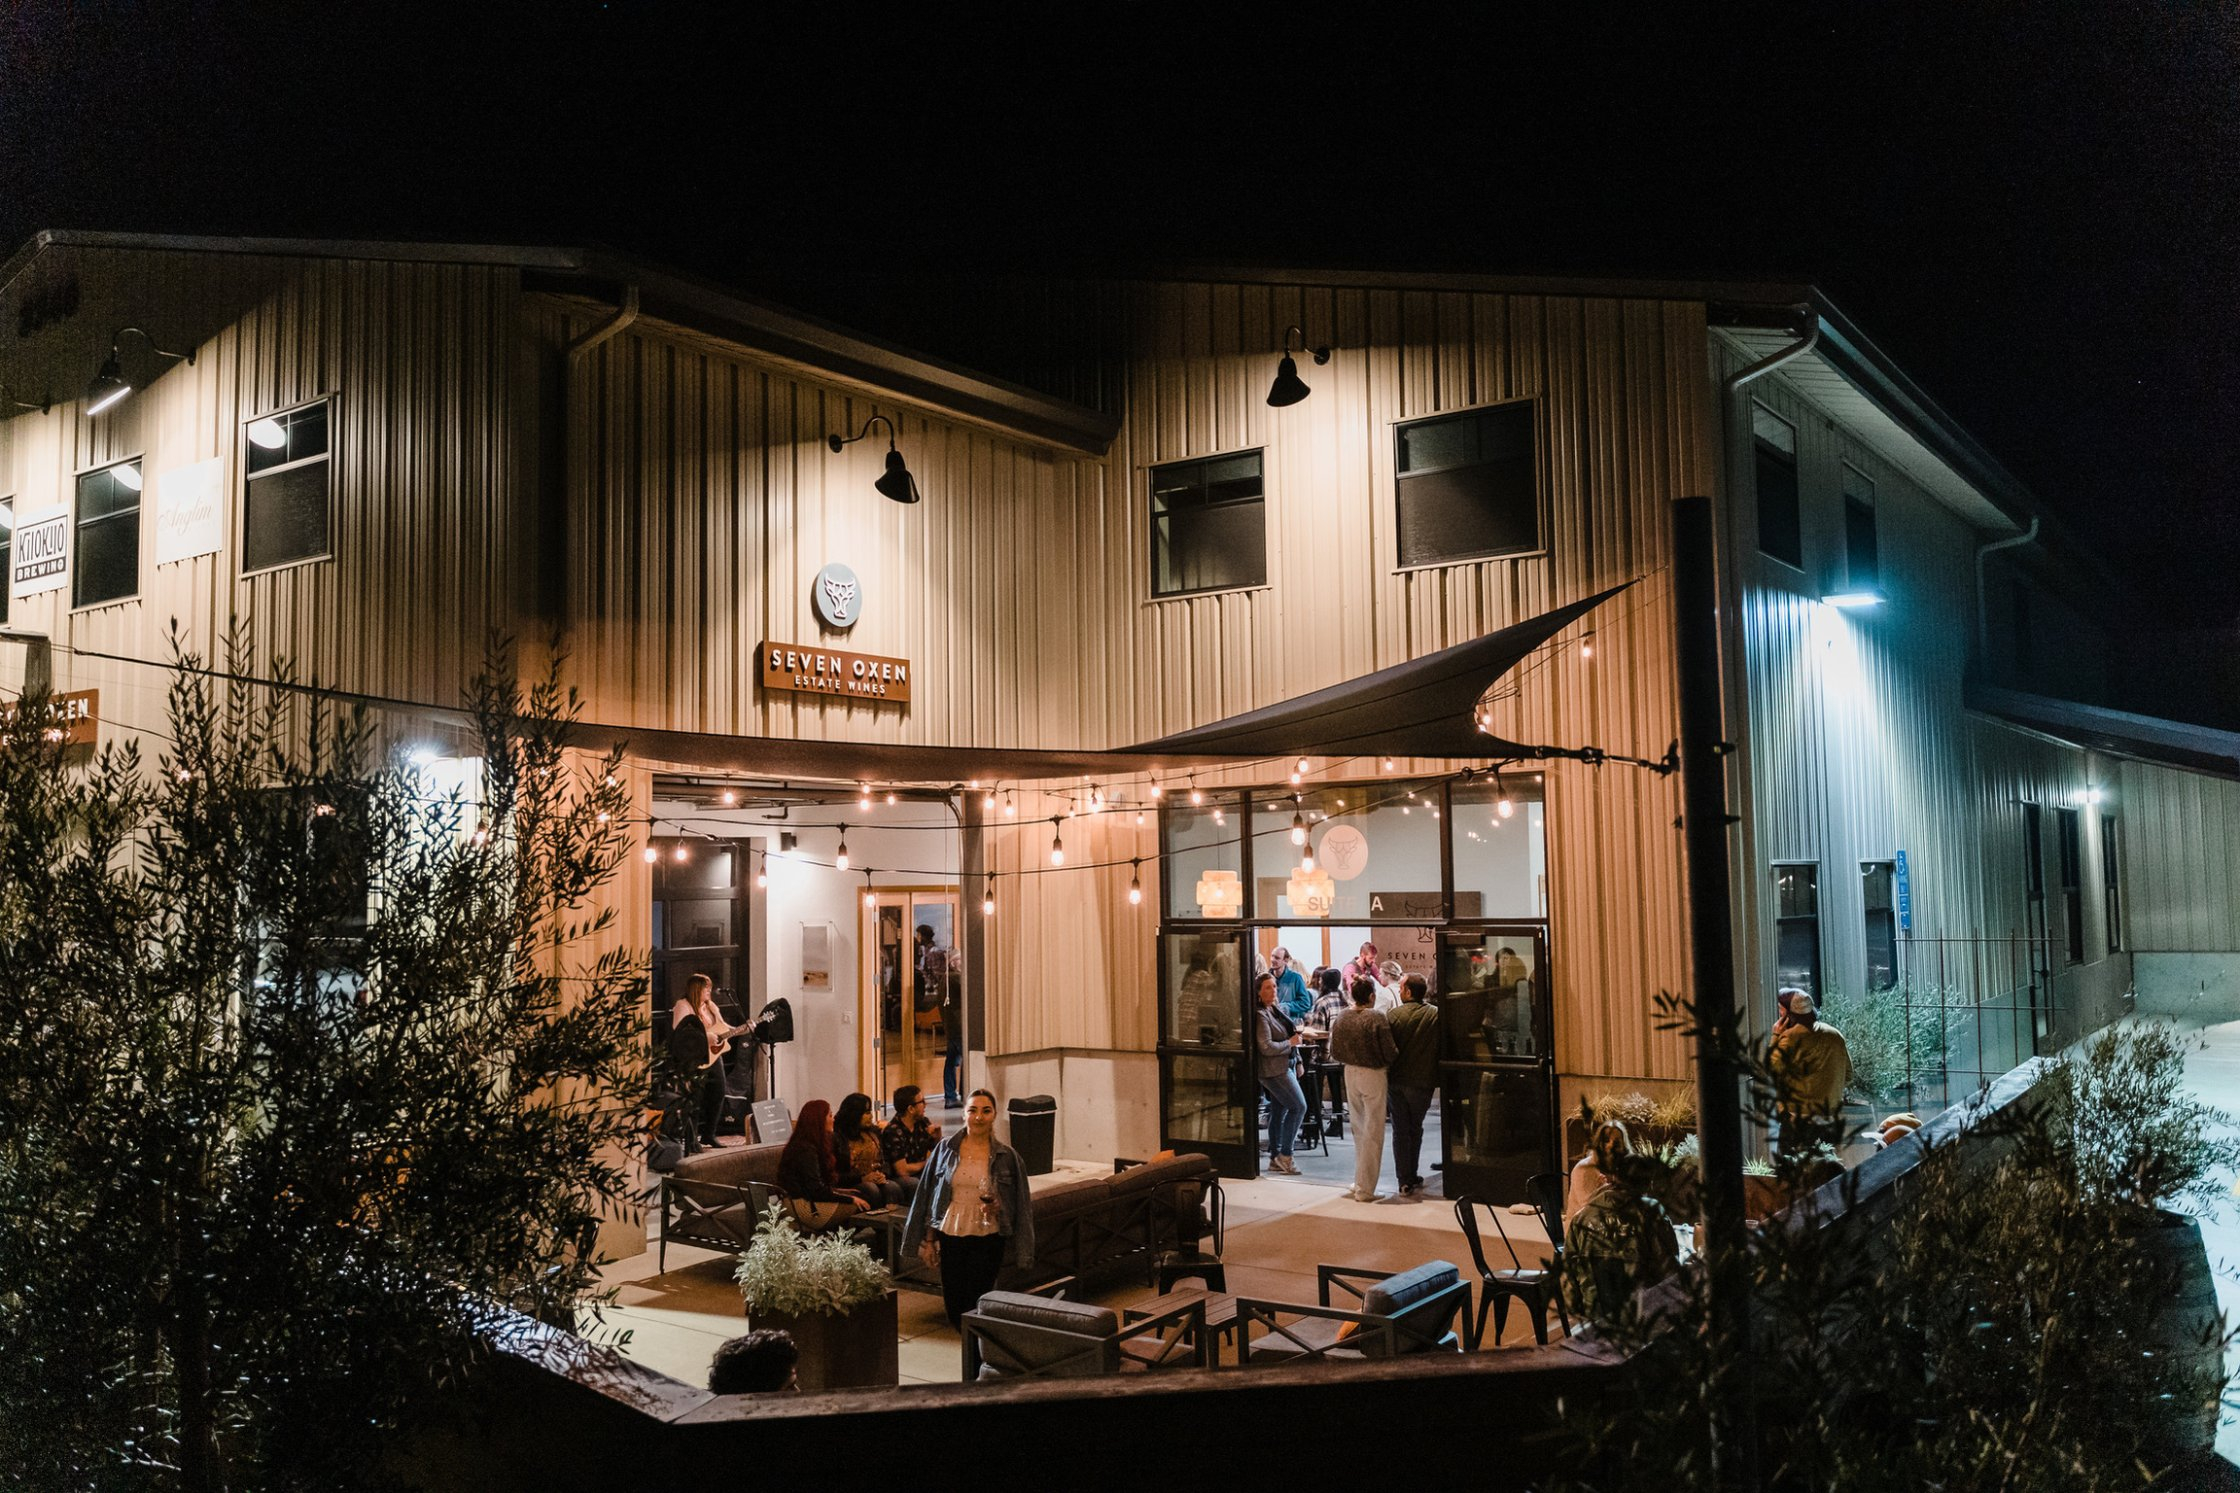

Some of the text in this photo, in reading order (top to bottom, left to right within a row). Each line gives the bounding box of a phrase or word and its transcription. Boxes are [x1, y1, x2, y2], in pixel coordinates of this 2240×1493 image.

[159, 495, 213, 536] Anglim
[16, 558, 65, 581] BREWING
[772, 649, 906, 681] SEVEN OXEN
[795, 675, 886, 693] ESTATE WINES
[1371, 895, 1384, 911] A
[1388, 951, 1426, 960] SEVEN
